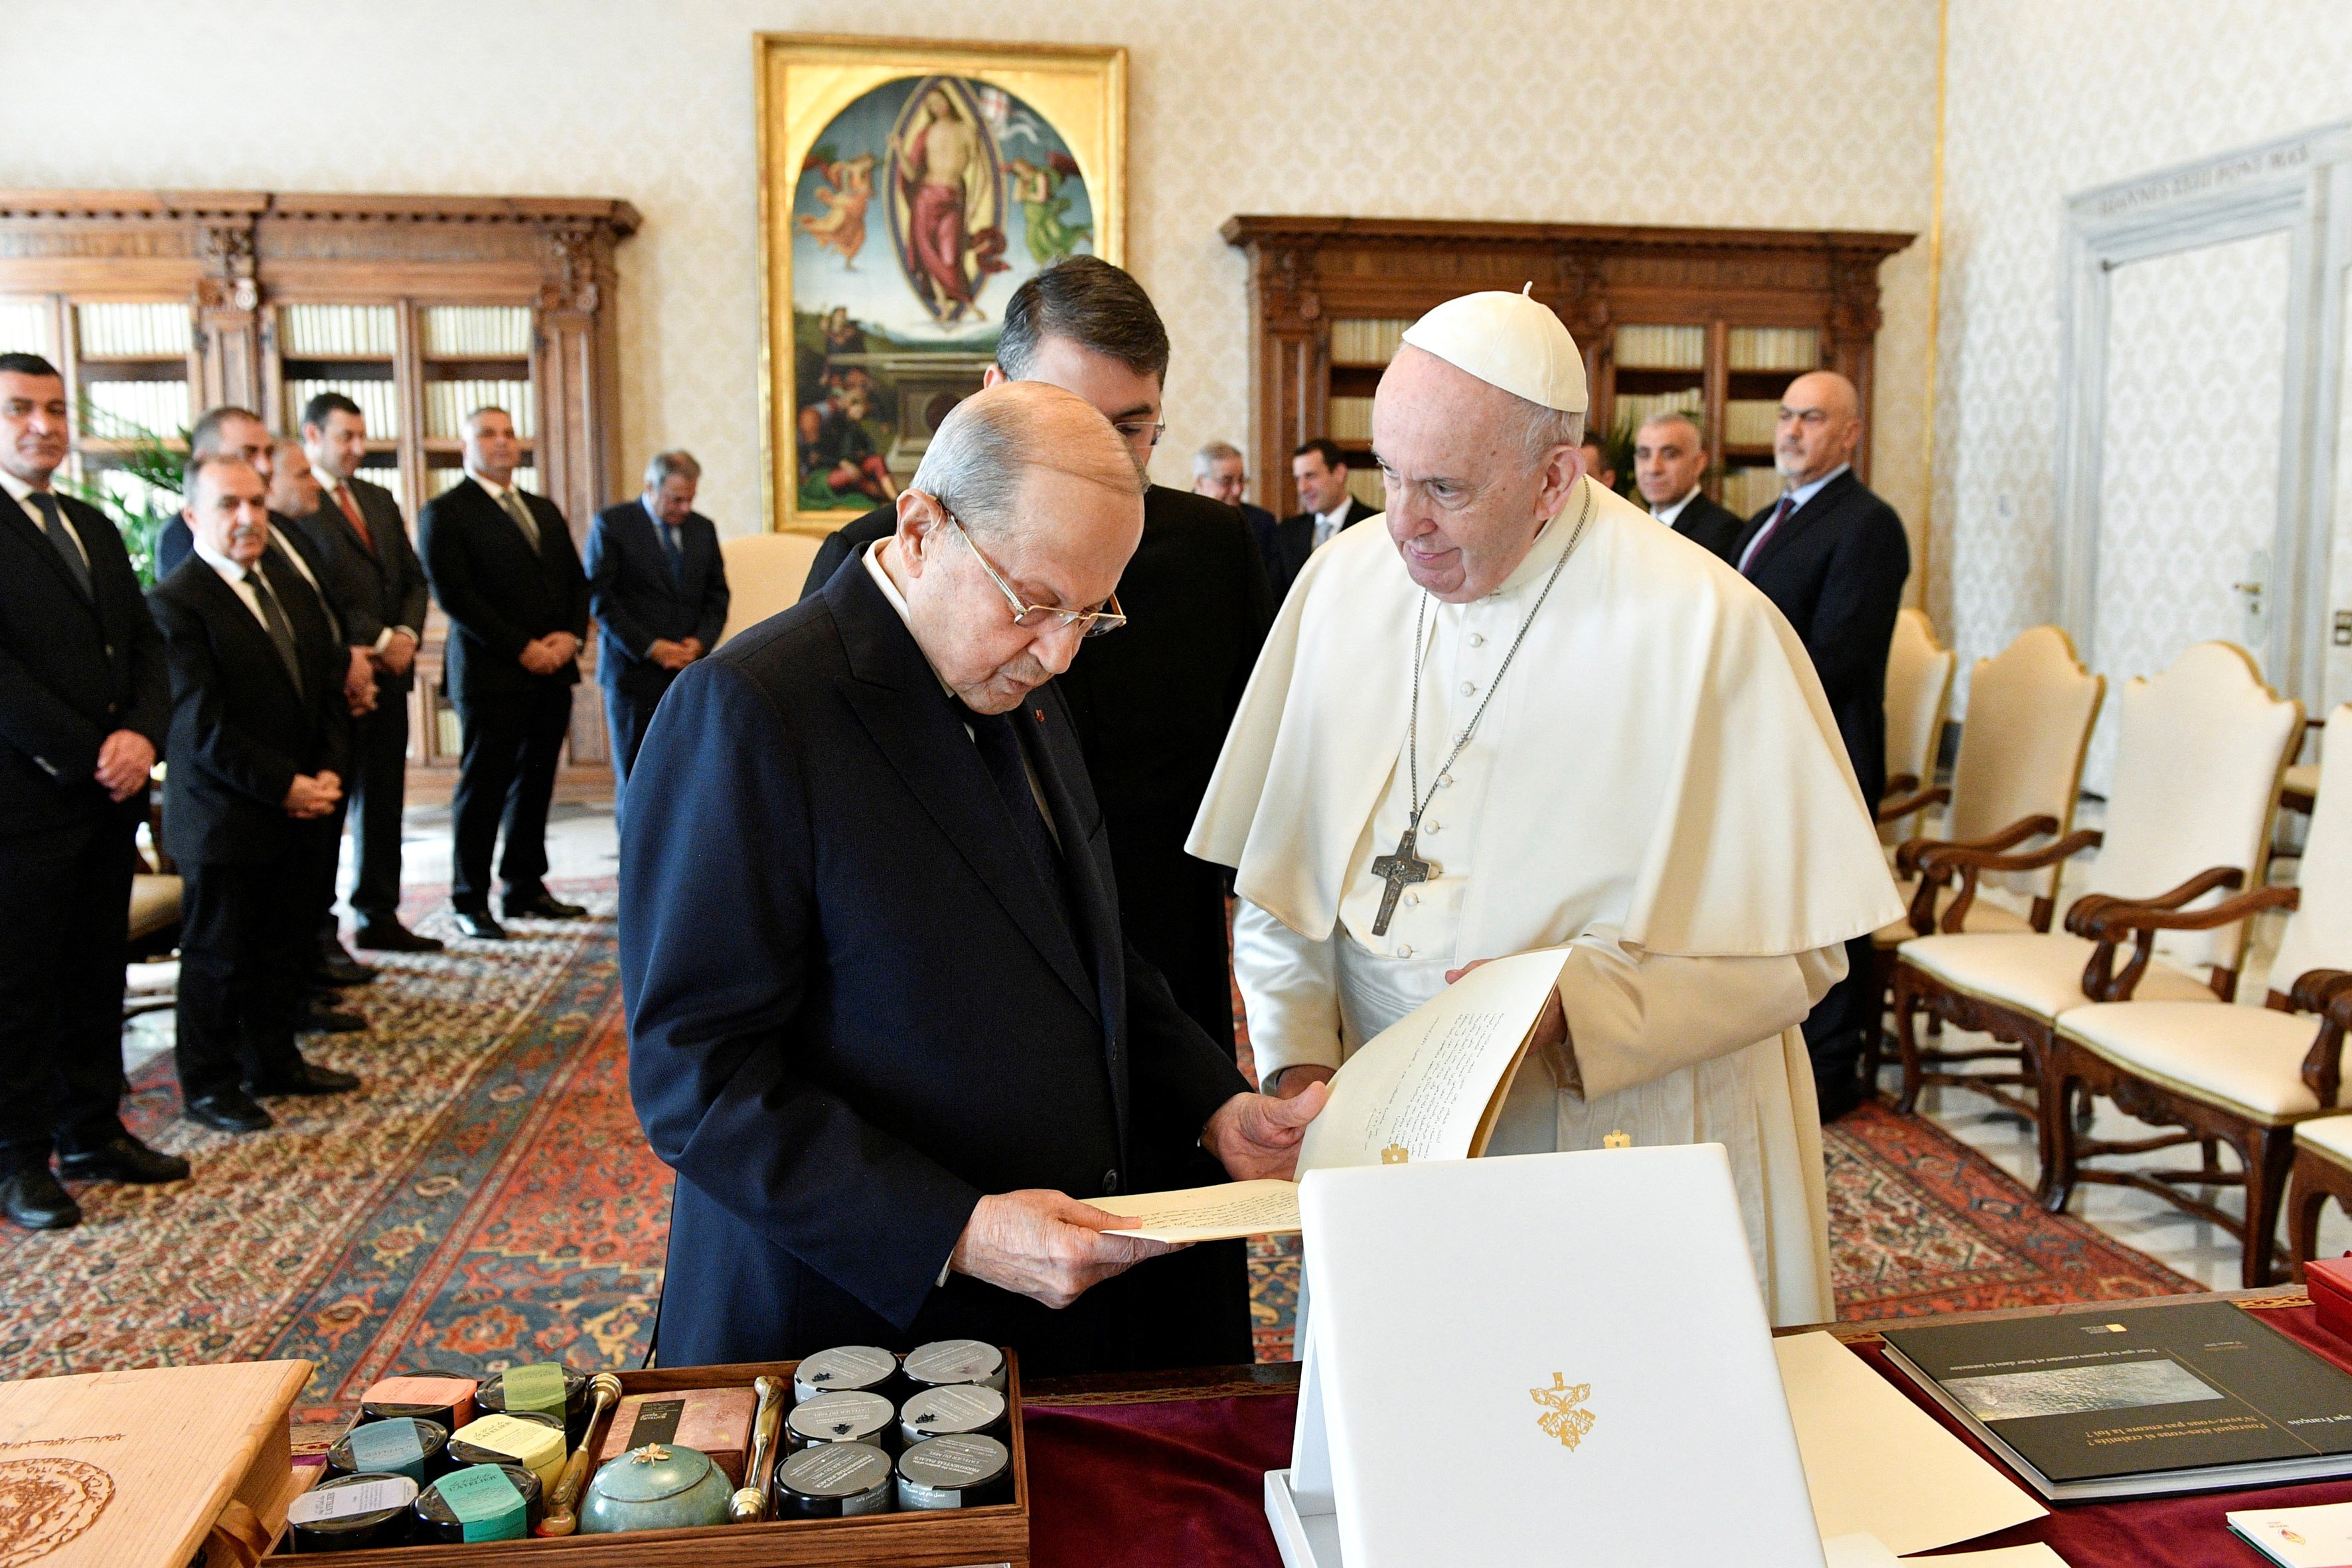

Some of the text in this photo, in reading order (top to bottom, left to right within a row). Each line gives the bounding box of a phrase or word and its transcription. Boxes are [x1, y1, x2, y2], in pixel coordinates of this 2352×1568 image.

[475, 1421, 513, 1441] L'ATELIER
[2127, 1424, 2163, 1433] encore
[2157, 1427, 2210, 1438] êtes-vous
[2211, 1422, 2268, 1433] Pourquoi
[2094, 1429, 2110, 1438] foi
[2094, 1435, 2143, 1445] craintifs
[449, 1475, 498, 1492] L'ATELIER
